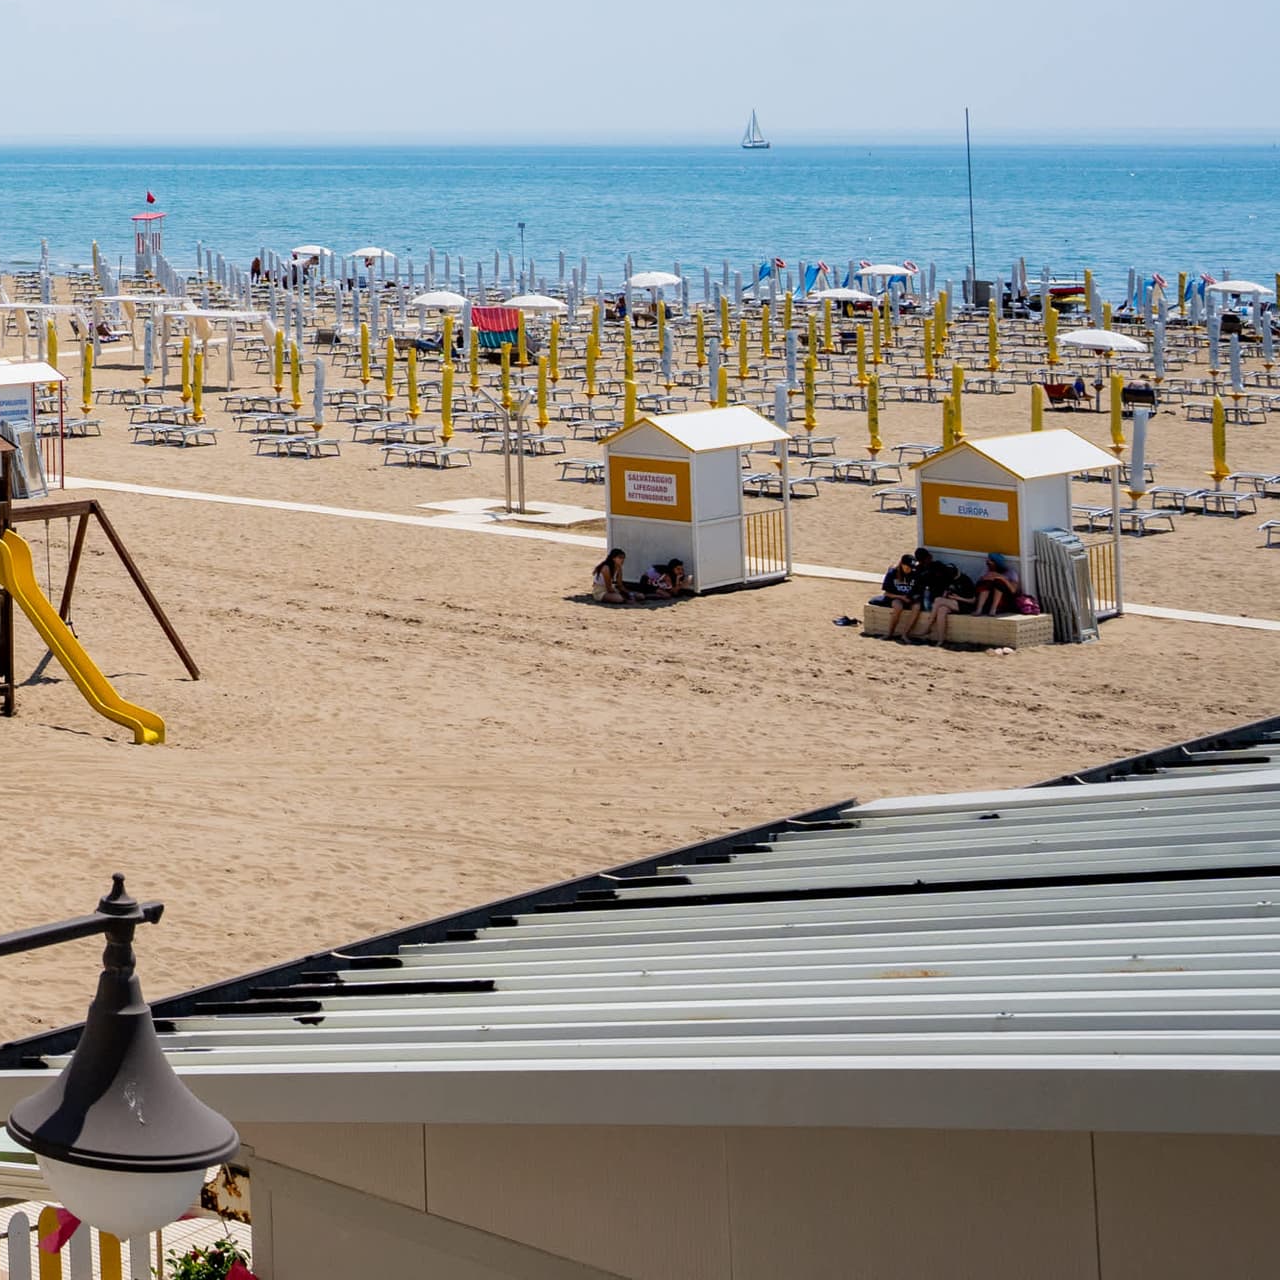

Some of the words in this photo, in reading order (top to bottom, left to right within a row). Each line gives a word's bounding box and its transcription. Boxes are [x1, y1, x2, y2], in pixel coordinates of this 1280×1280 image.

[627, 473, 673, 485] SALVATAGGIO
[633, 483, 668, 493] LIFEGUARD
[958, 505, 989, 518] EUROPA
